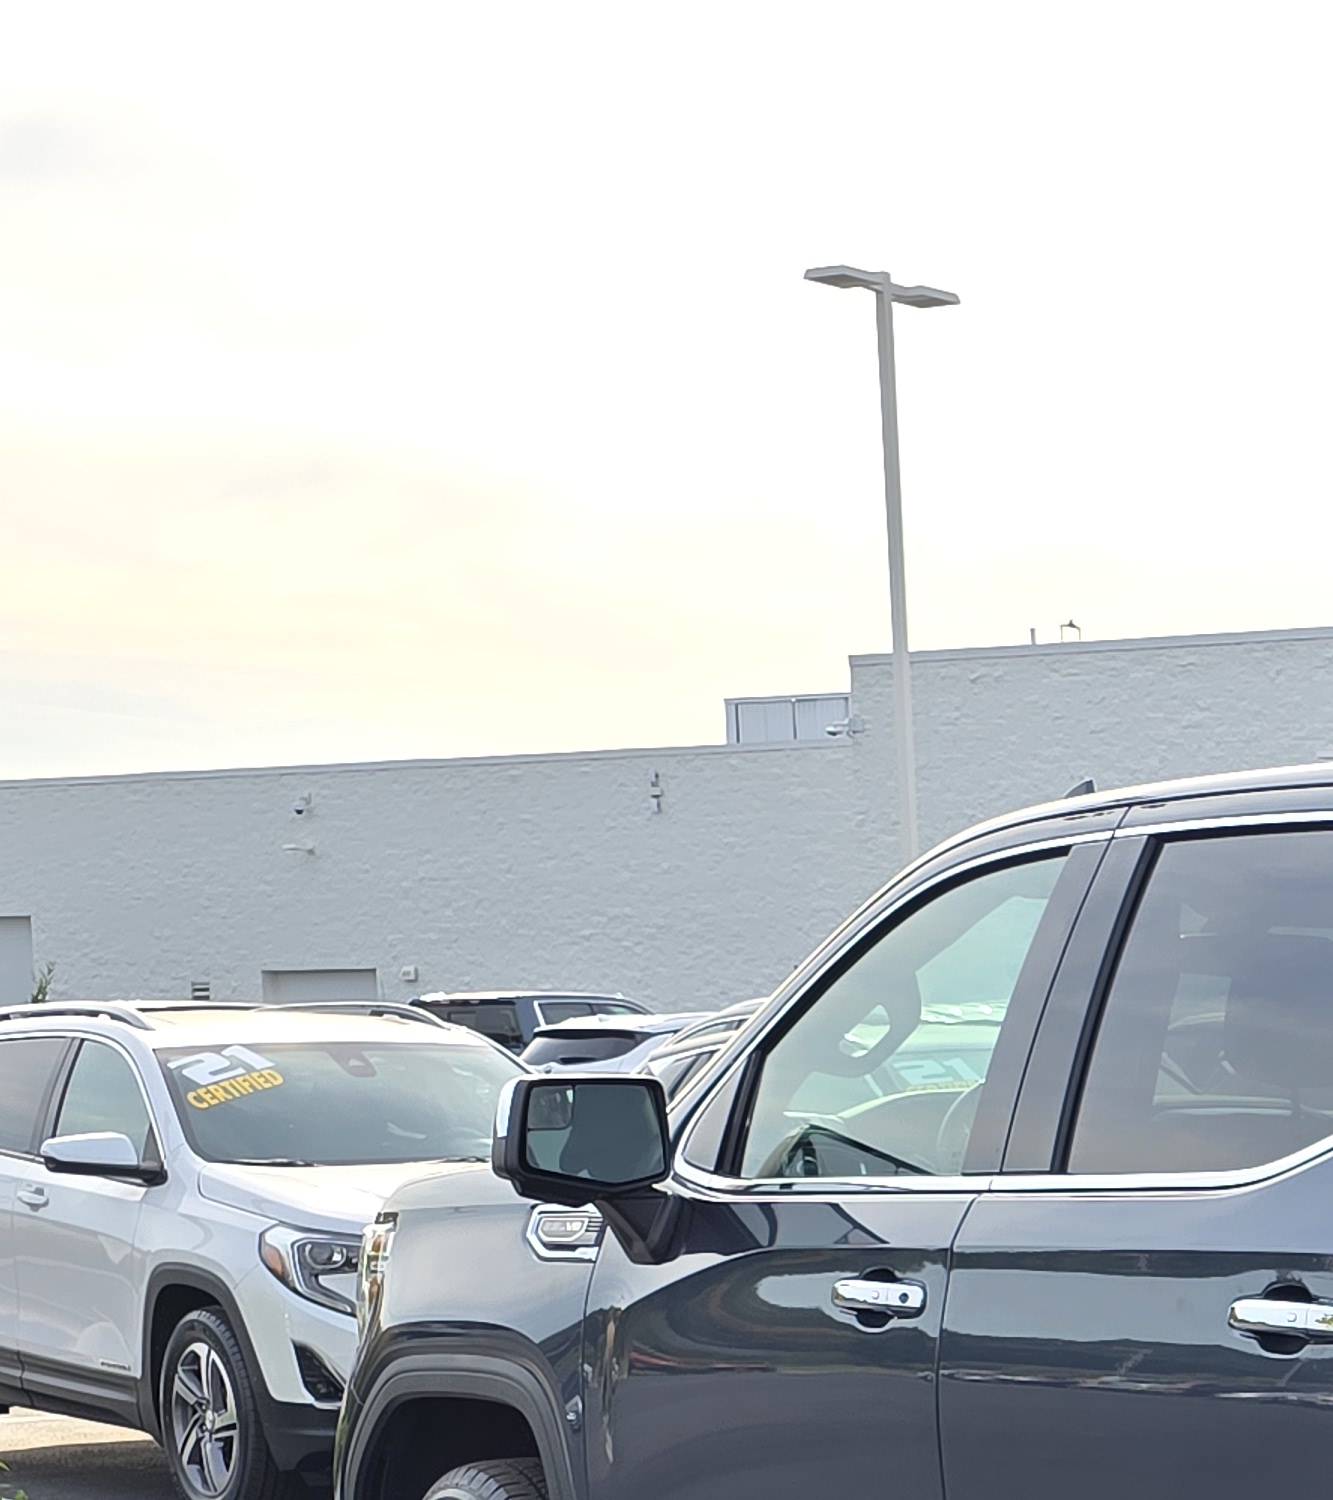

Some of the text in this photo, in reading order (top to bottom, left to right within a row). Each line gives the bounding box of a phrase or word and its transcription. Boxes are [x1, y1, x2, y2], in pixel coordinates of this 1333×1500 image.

[166, 1045, 276, 1086] 21
[892, 1057, 980, 1086] 21
[186, 1069, 284, 1109] CERTIFIED
